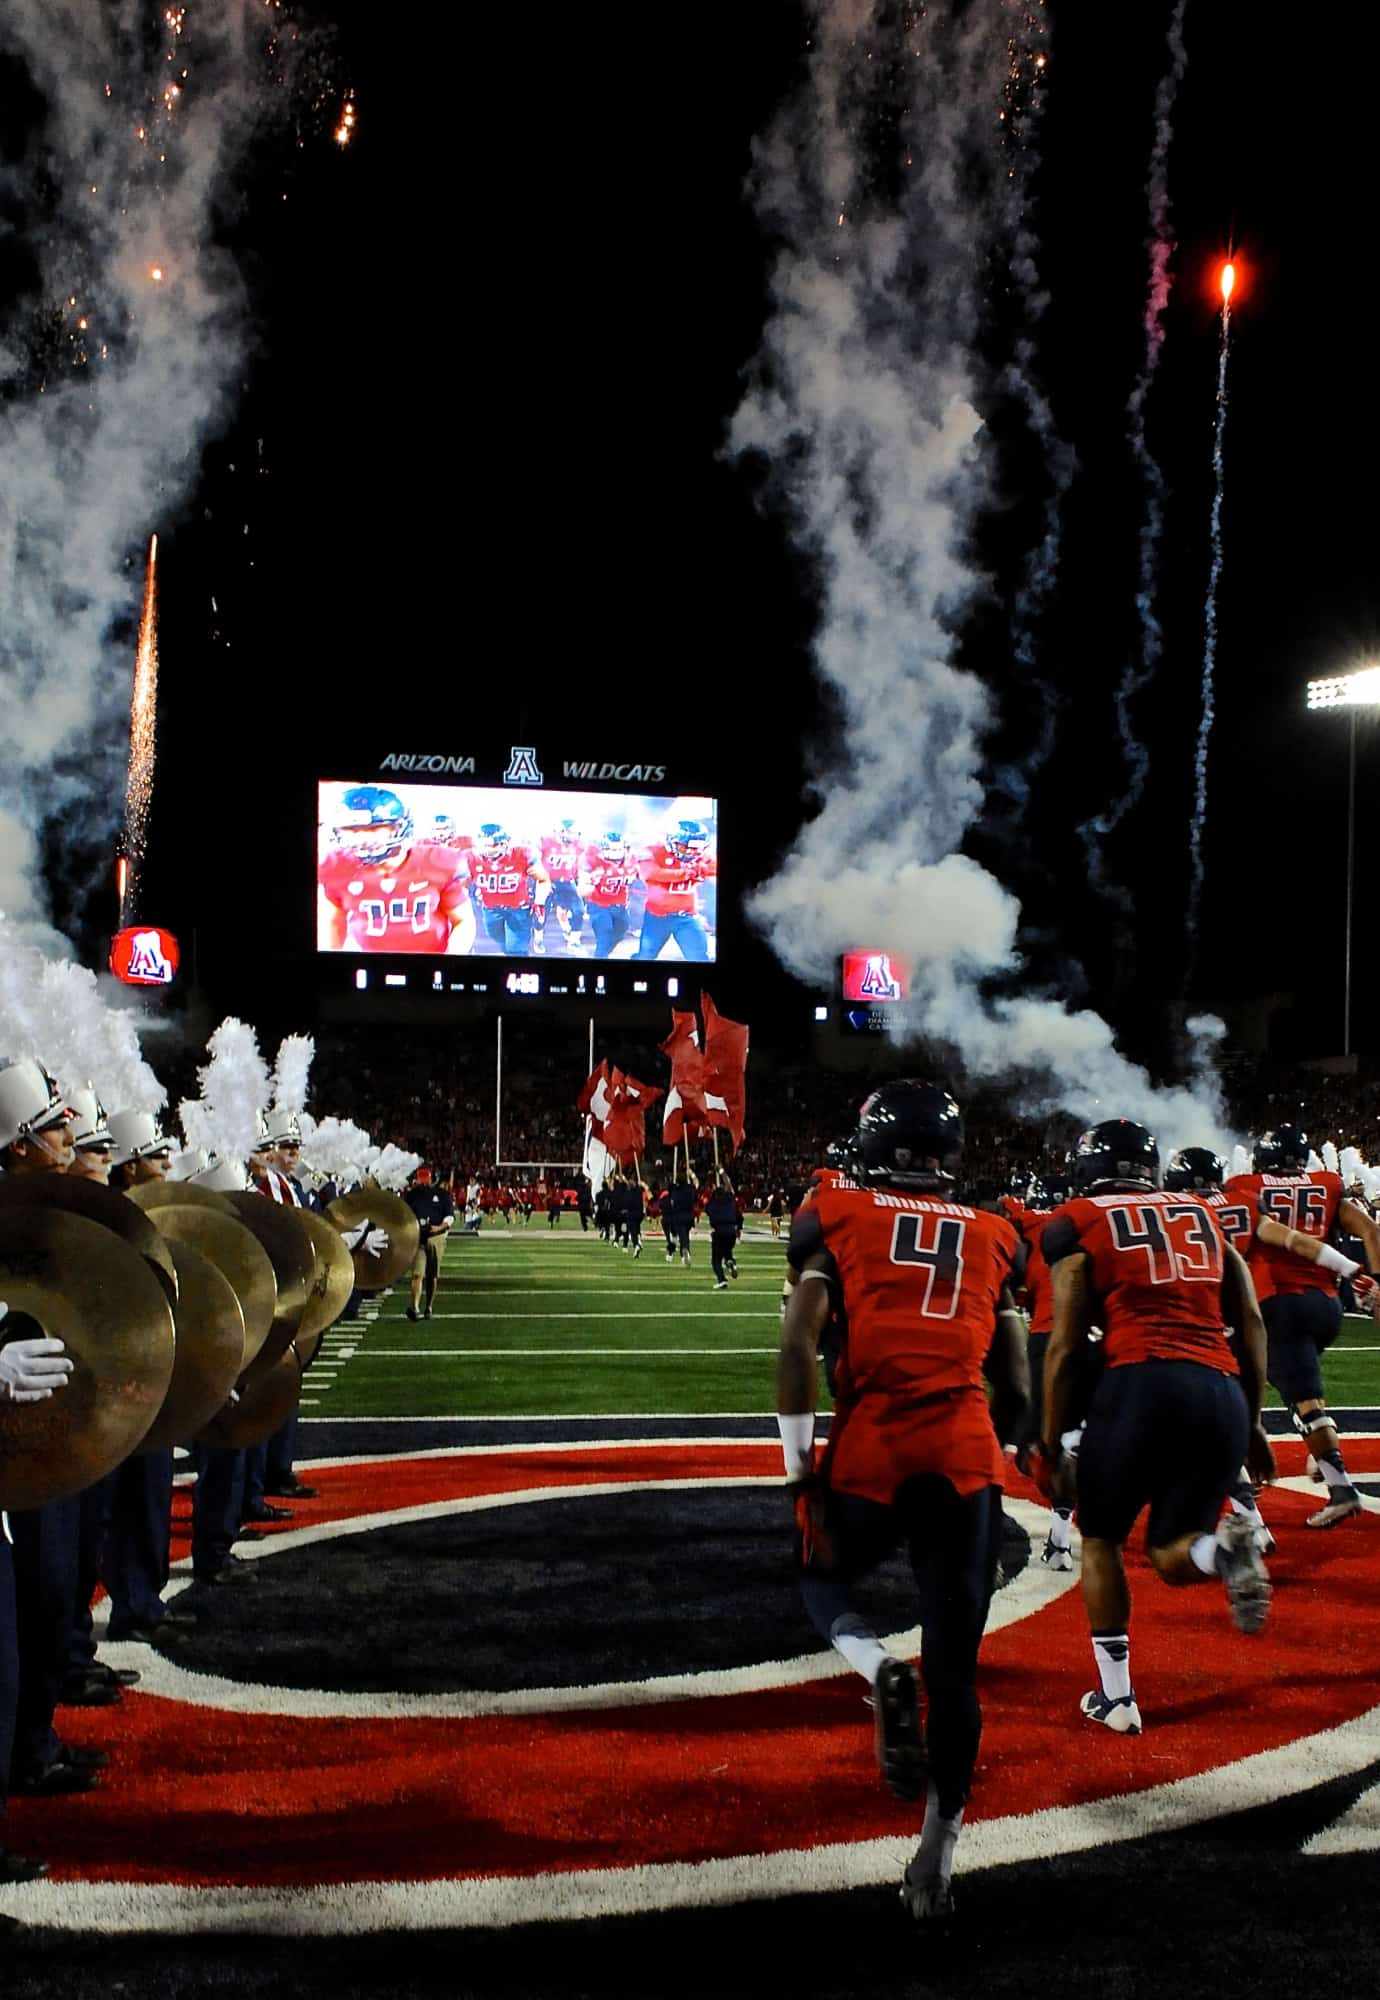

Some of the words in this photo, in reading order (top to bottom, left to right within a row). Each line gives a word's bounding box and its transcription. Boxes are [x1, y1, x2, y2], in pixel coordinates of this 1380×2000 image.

[379, 752, 476, 774] ARIZONA
[503, 746, 543, 785] A
[562, 760, 667, 783] WILDCATS
[127, 930, 173, 983] A
[861, 953, 901, 1000] A
[1260, 1185, 1327, 1239] 56
[889, 1211, 966, 1319] 4
[1106, 1203, 1224, 1285] 43
